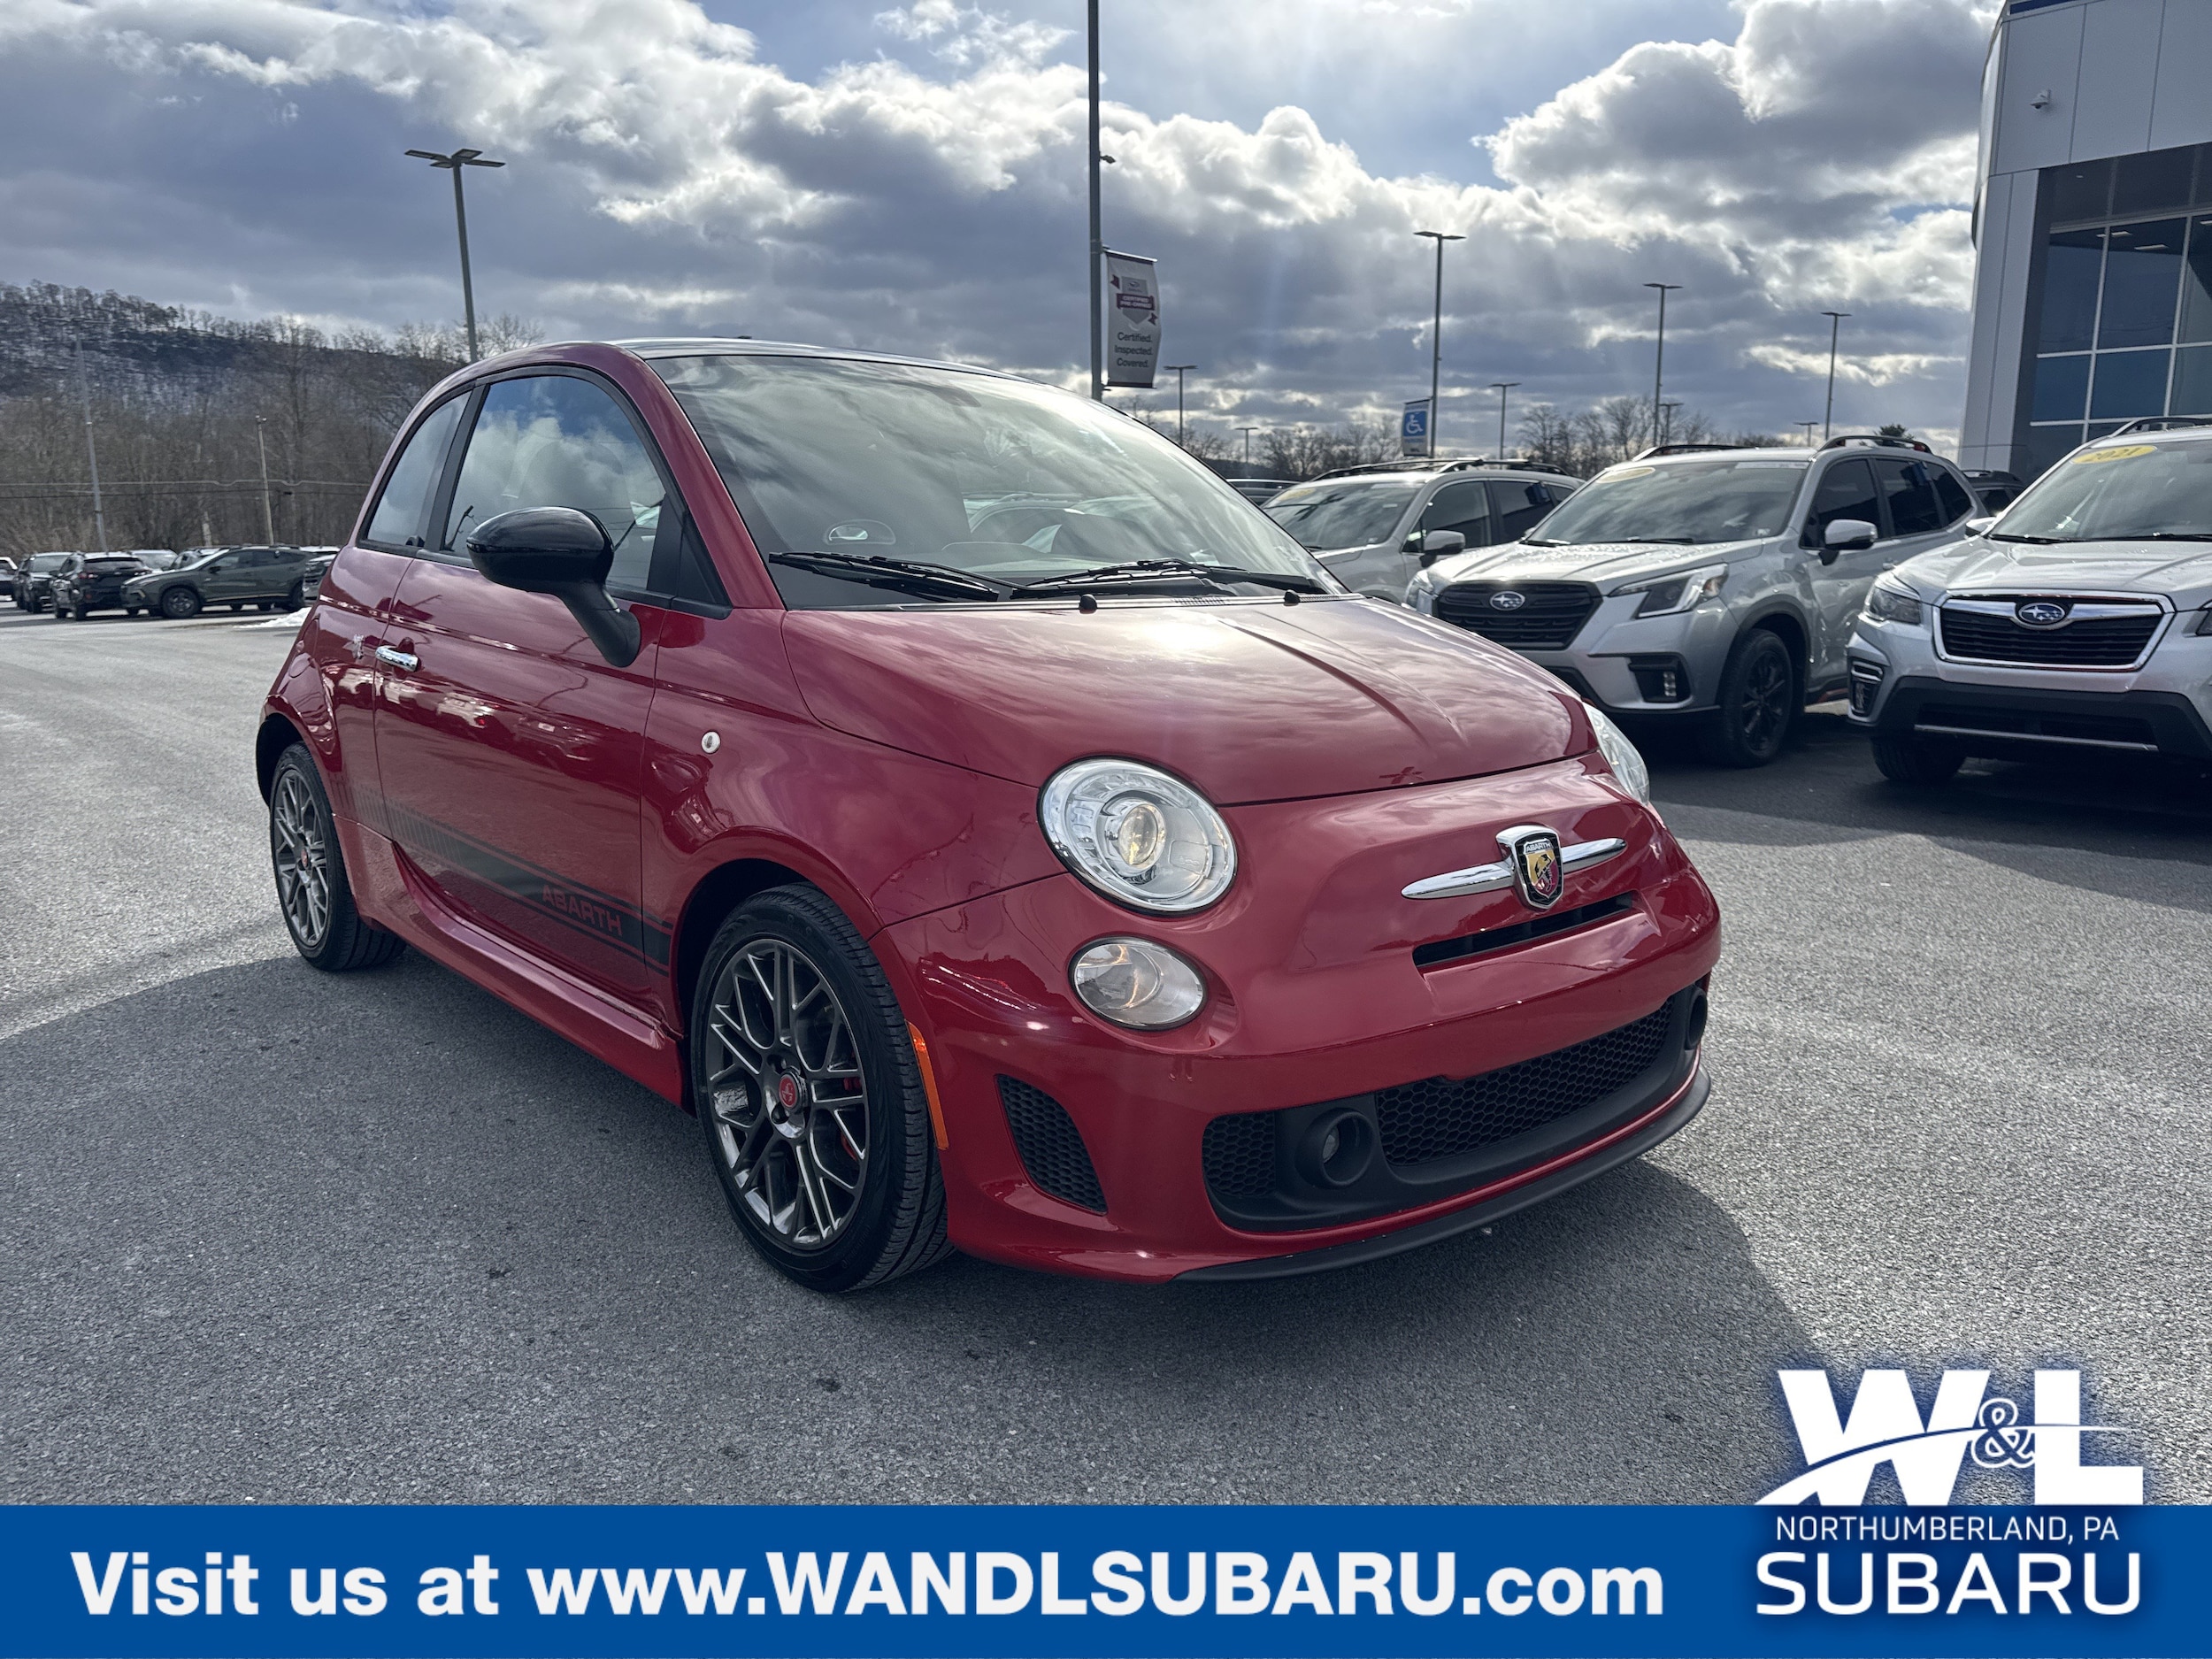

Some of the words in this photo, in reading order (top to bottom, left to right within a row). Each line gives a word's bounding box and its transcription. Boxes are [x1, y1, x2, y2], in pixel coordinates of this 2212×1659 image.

[1118, 332, 1152, 342] Certified.
[1115, 345, 1153, 356] Inspected.
[1117, 357, 1149, 367] Covered.
[1526, 841, 1552, 853] ABARTH
[542, 886, 622, 935] ABARTH
